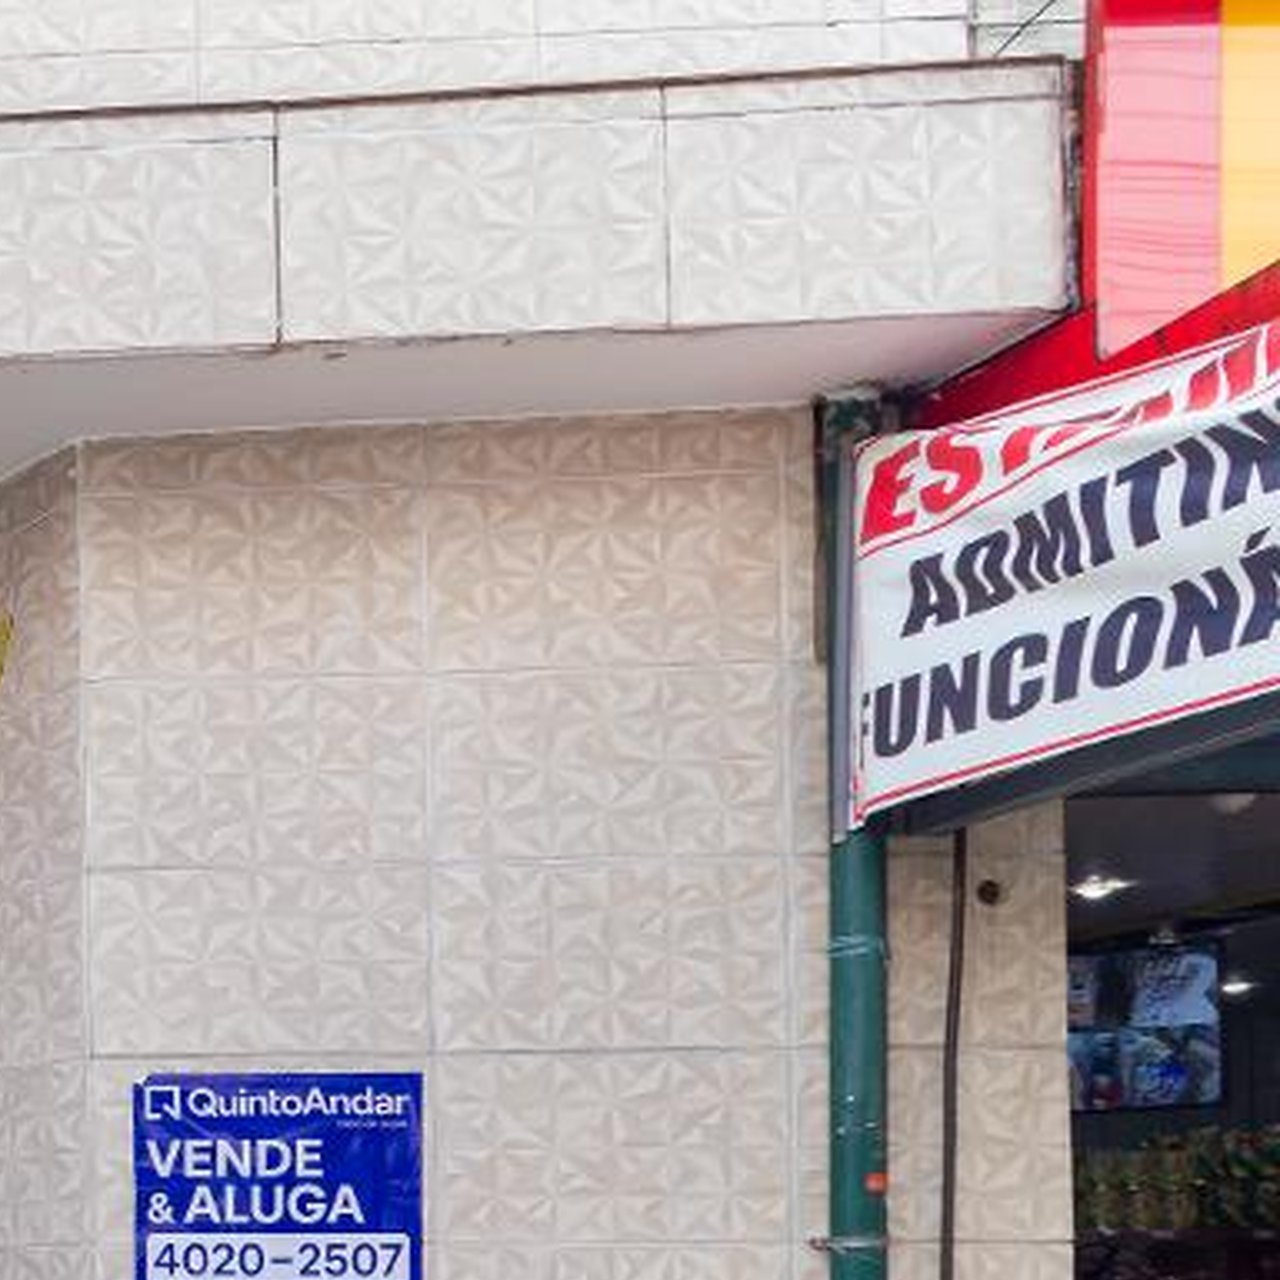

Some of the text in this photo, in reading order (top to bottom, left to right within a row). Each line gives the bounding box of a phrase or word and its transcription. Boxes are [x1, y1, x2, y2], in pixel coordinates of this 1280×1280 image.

[188, 1086, 411, 1118] QuintoAndar
[146, 1138, 325, 1179] VENDE
[147, 1184, 366, 1225] & ALUGA
[153, 1242, 404, 1278] 4020-2507
